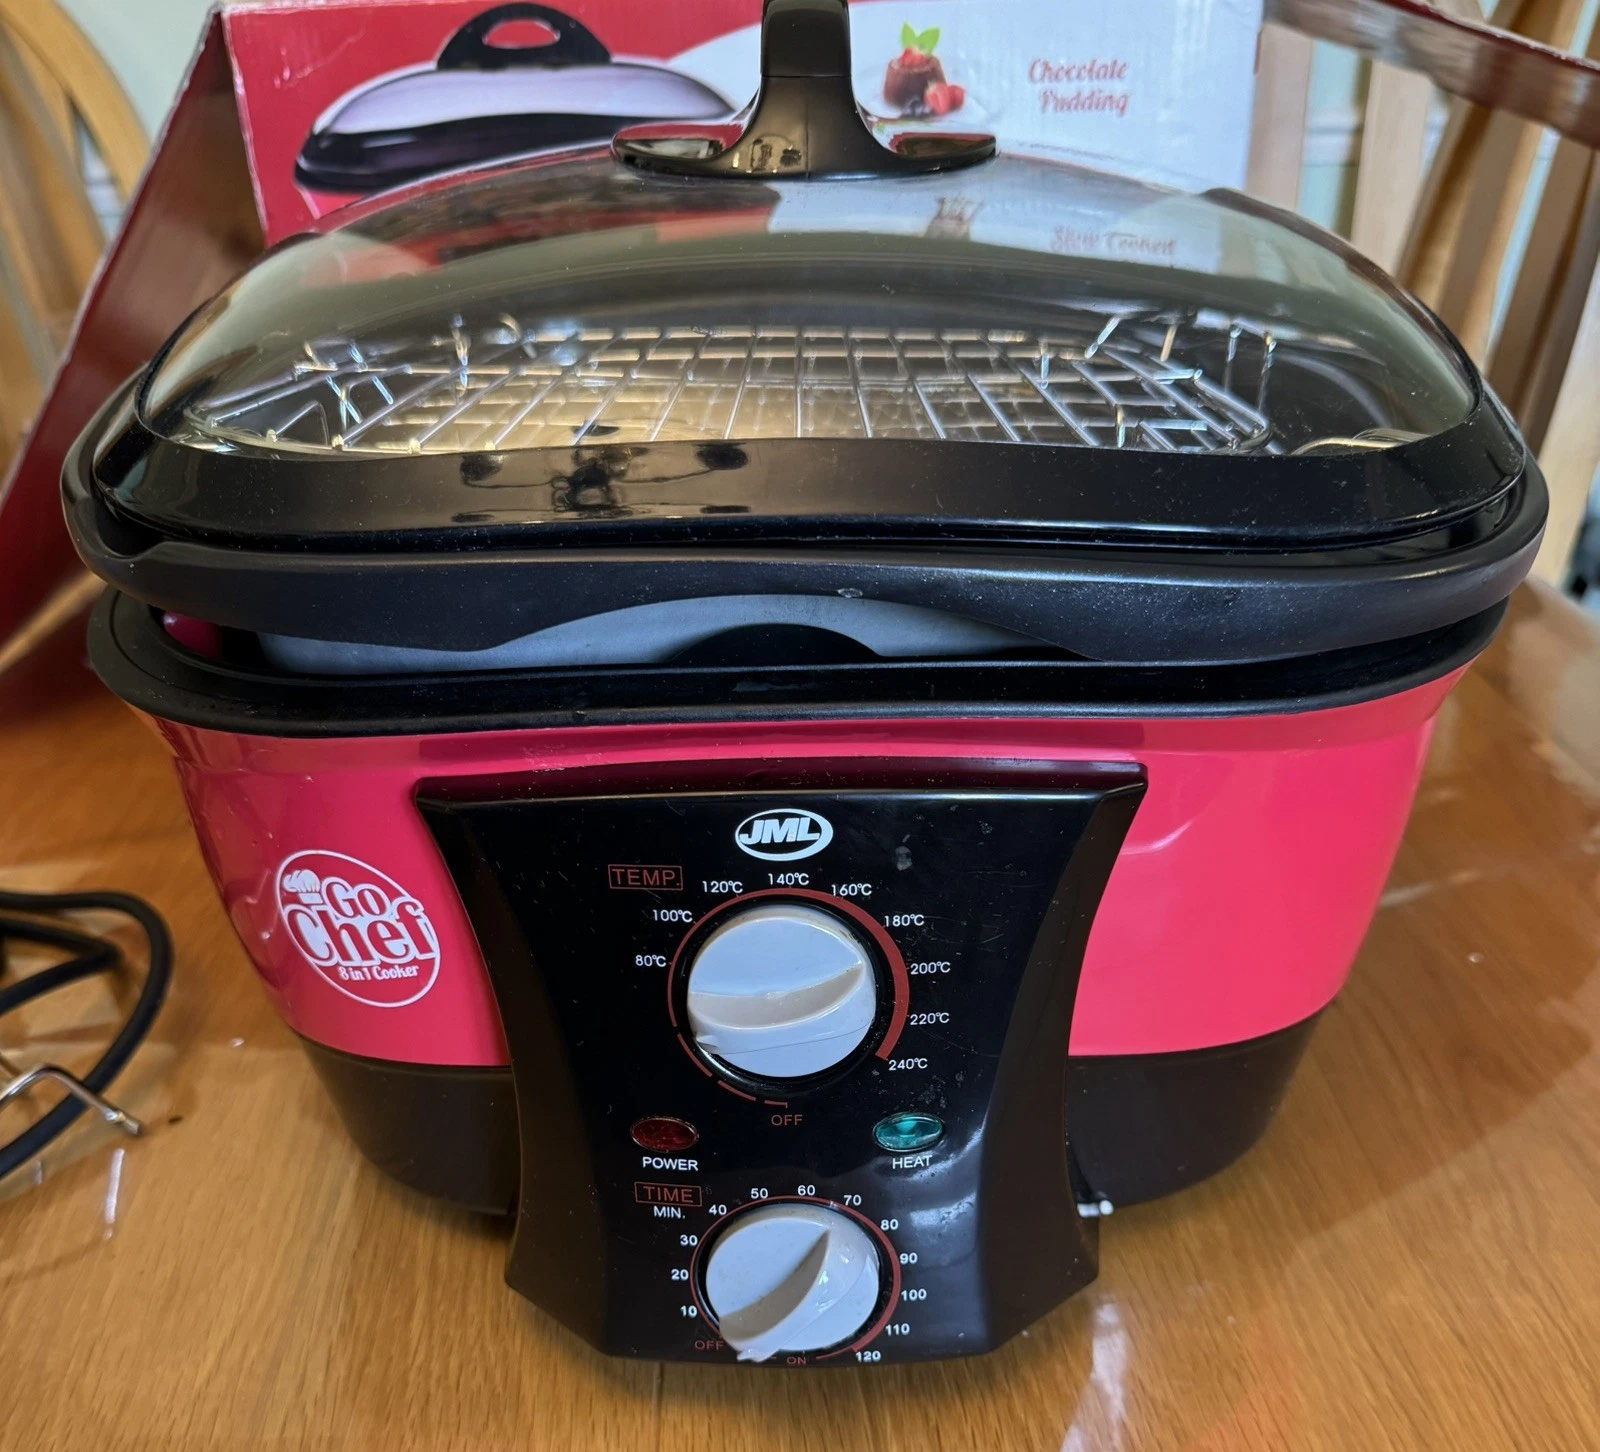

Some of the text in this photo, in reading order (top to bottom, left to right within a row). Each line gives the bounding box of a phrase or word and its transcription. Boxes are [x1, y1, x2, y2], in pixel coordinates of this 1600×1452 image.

[1028, 58, 1129, 83] Chocolate
[1041, 90, 1130, 117] Pudding
[738, 817, 822, 846] JML
[321, 876, 391, 919] Go
[285, 896, 438, 967] Chef
[371, 964, 420, 981] Cooker
[770, 1114, 804, 1127] OFF
[641, 1156, 699, 1172] POWER
[891, 1154, 934, 1170] HEAT
[642, 1184, 694, 1204] TIME
[750, 1187, 770, 1200] 50
[796, 1184, 817, 1197] 60
[843, 1194, 863, 1207] 70
[652, 1205, 687, 1220] MIN.
[708, 1204, 728, 1217] 40
[879, 1218, 900, 1232] 80
[679, 1234, 699, 1247] 30
[899, 1252, 919, 1265] 90
[670, 1268, 690, 1281] 20
[900, 1288, 928, 1301] 100
[679, 1305, 698, 1318] 10
[884, 1322, 911, 1336] 110
[694, 1340, 725, 1351] OFF
[786, 1356, 807, 1366] ON
[854, 1350, 882, 1364] 120
